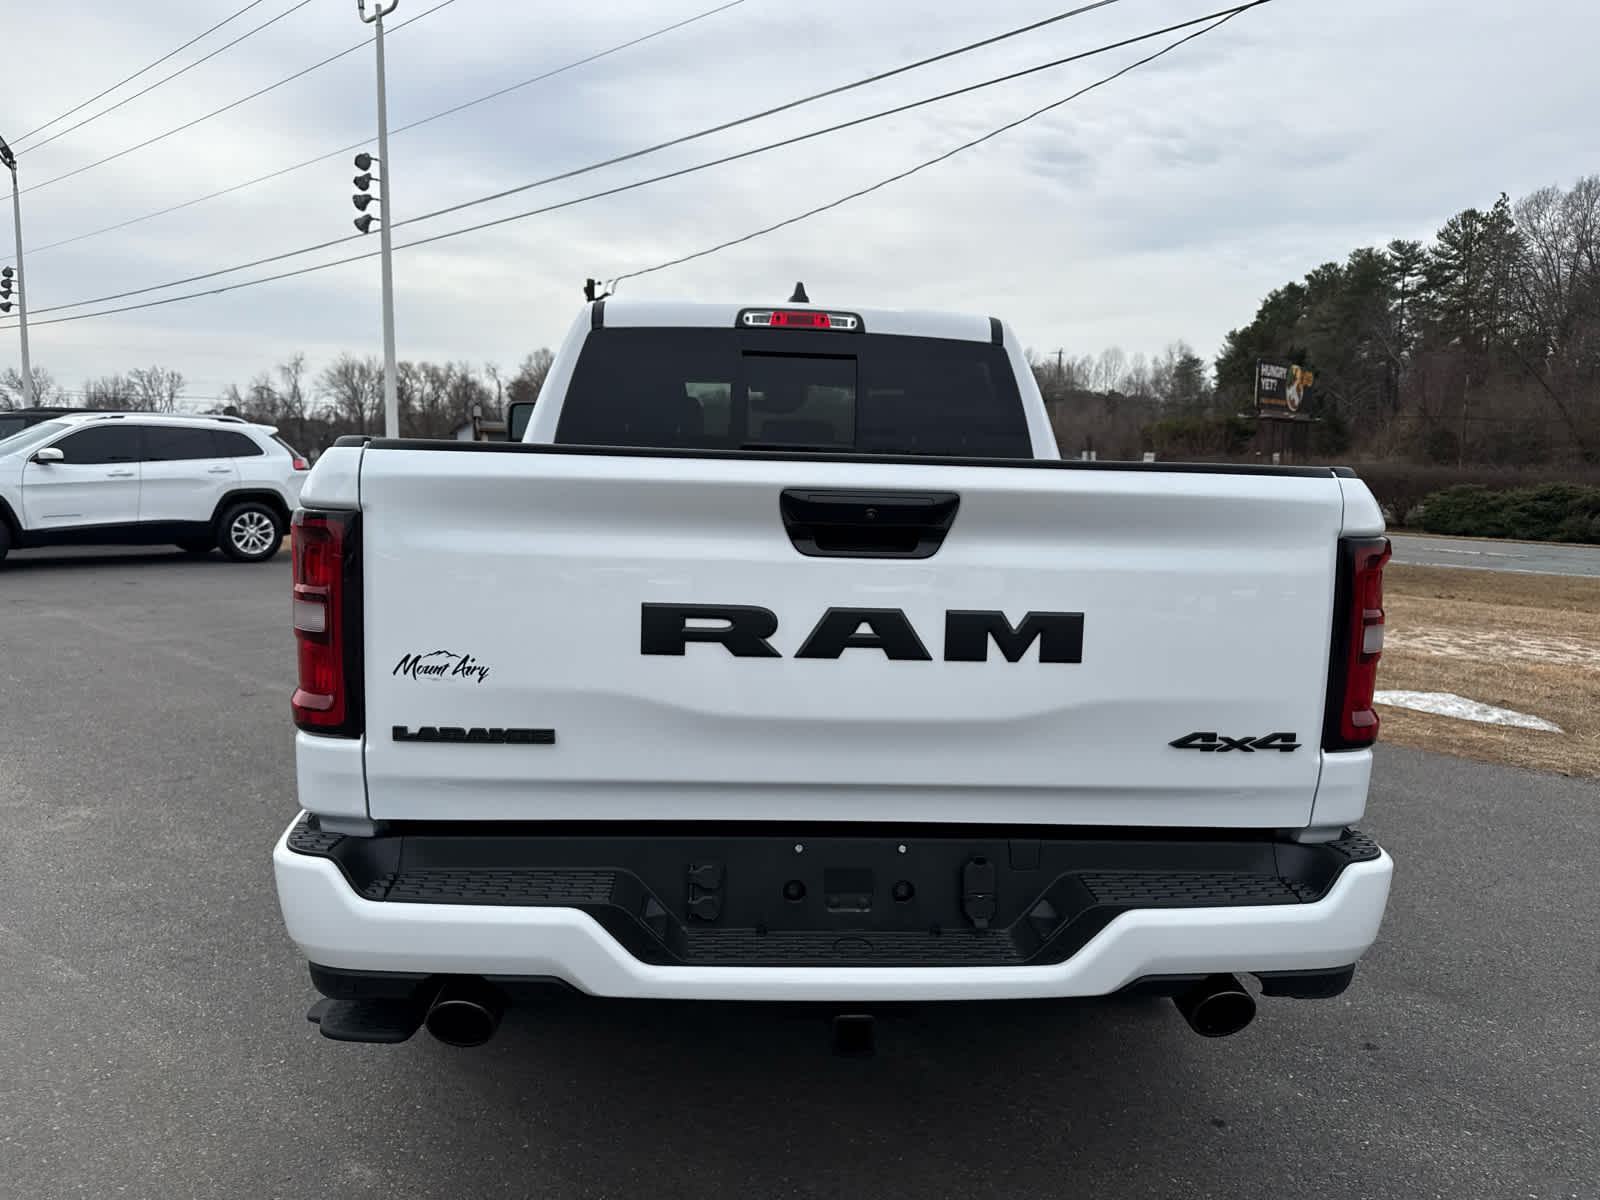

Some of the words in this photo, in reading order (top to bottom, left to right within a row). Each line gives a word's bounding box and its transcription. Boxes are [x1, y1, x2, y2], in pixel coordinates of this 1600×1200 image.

[641, 602, 1085, 664] RAM
[393, 653, 450, 680] Mount
[452, 654, 490, 684] Airy
[1168, 732, 1302, 753] 4x4
